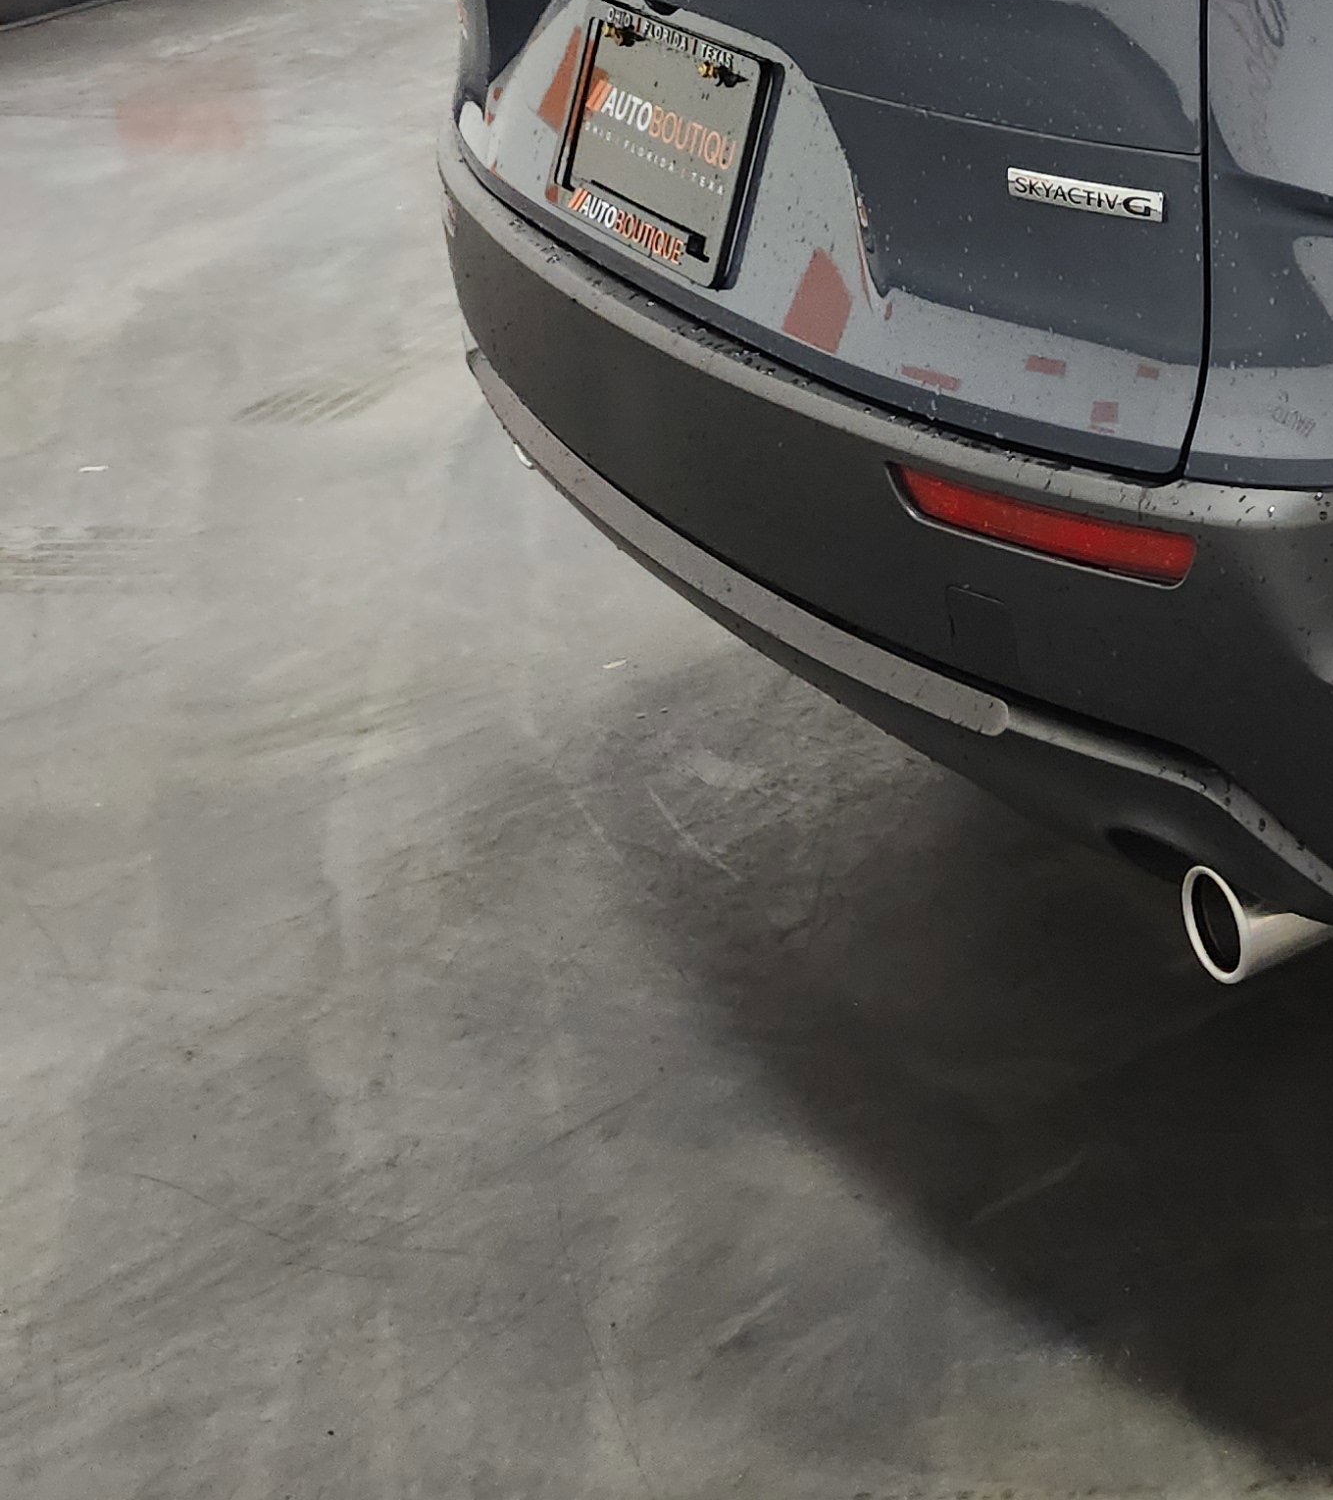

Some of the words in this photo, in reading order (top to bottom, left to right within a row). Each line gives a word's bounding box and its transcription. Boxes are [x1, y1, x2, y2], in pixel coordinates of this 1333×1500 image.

[607, 7, 633, 28] OHIO
[642, 20, 689, 52] FLORIDA
[700, 43, 734, 68] TEXAS
[601, 87, 737, 170] AUTOBOUTIQU
[624, 140, 675, 172] FLORIDA
[691, 172, 725, 196] TEXA
